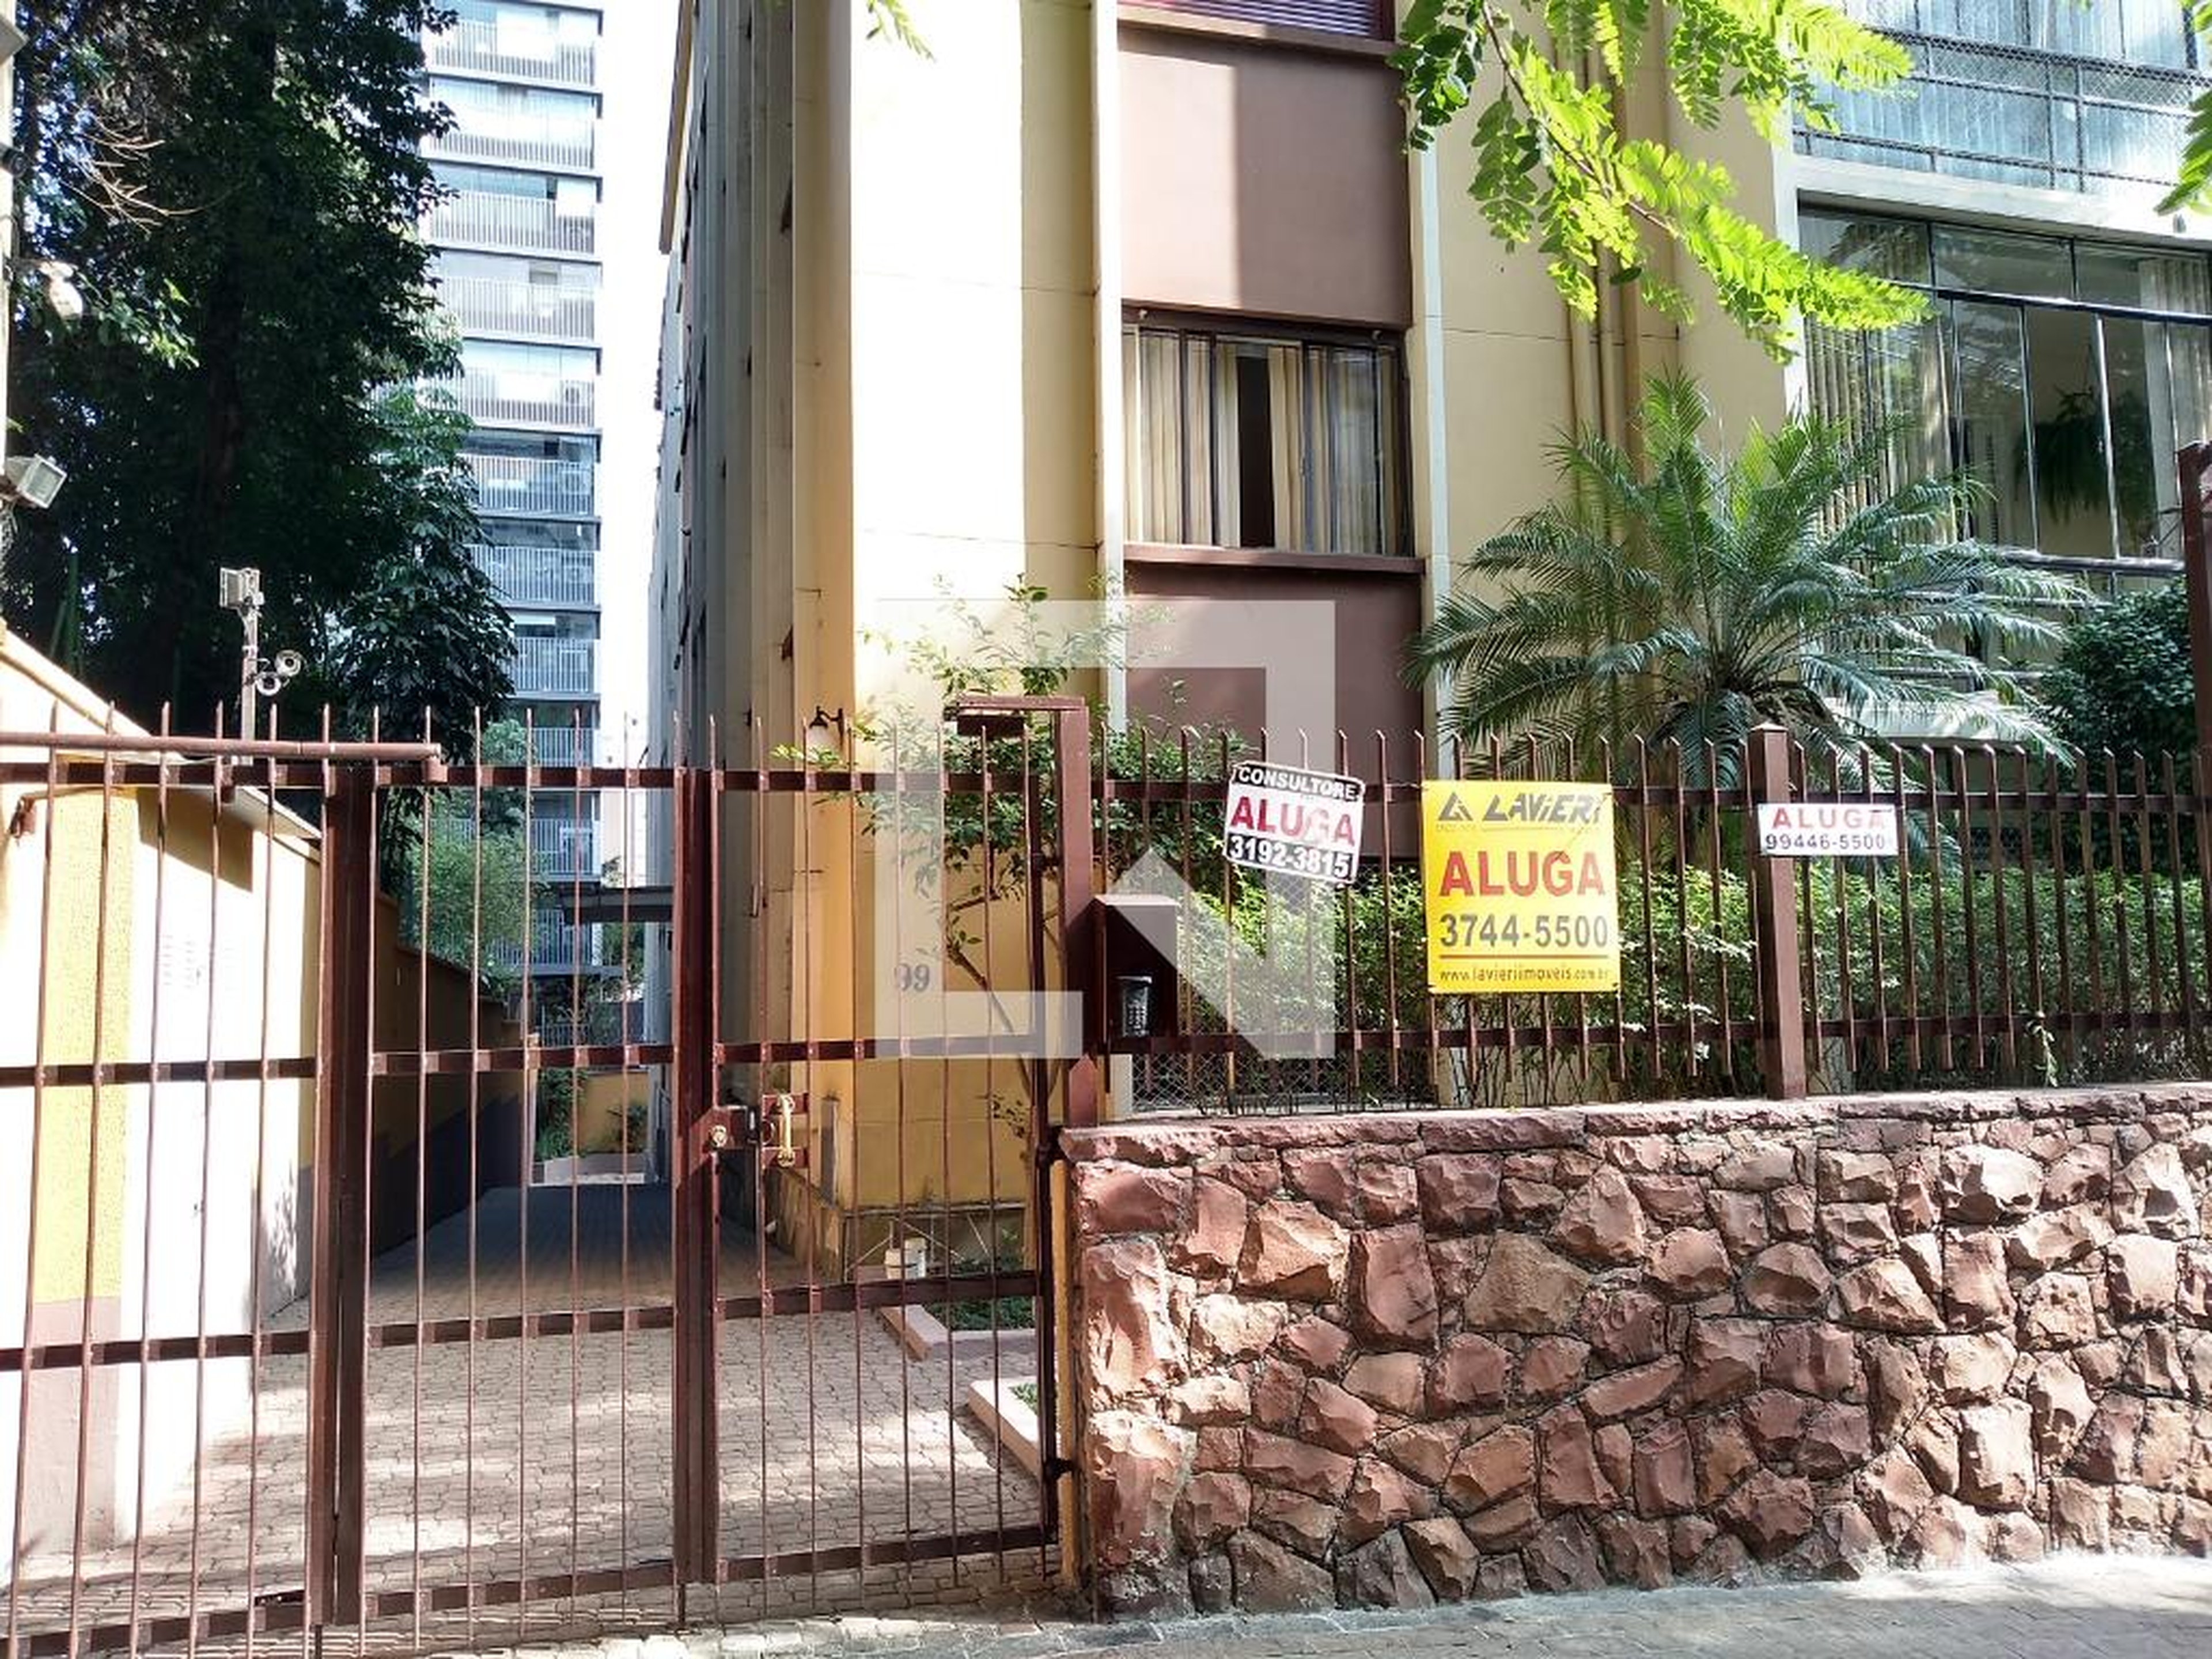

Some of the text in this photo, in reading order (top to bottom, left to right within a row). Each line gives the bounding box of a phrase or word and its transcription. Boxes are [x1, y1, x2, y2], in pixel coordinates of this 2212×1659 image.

[1238, 766, 1359, 801] CONSULTORE
[1230, 796, 1355, 848] ALUGA
[1230, 836, 1350, 878] 3192-3815
[1766, 834, 1885, 850] 99446-5500
[1441, 851, 1604, 896] ALUGA
[1440, 914, 1608, 948] 3744-5500
